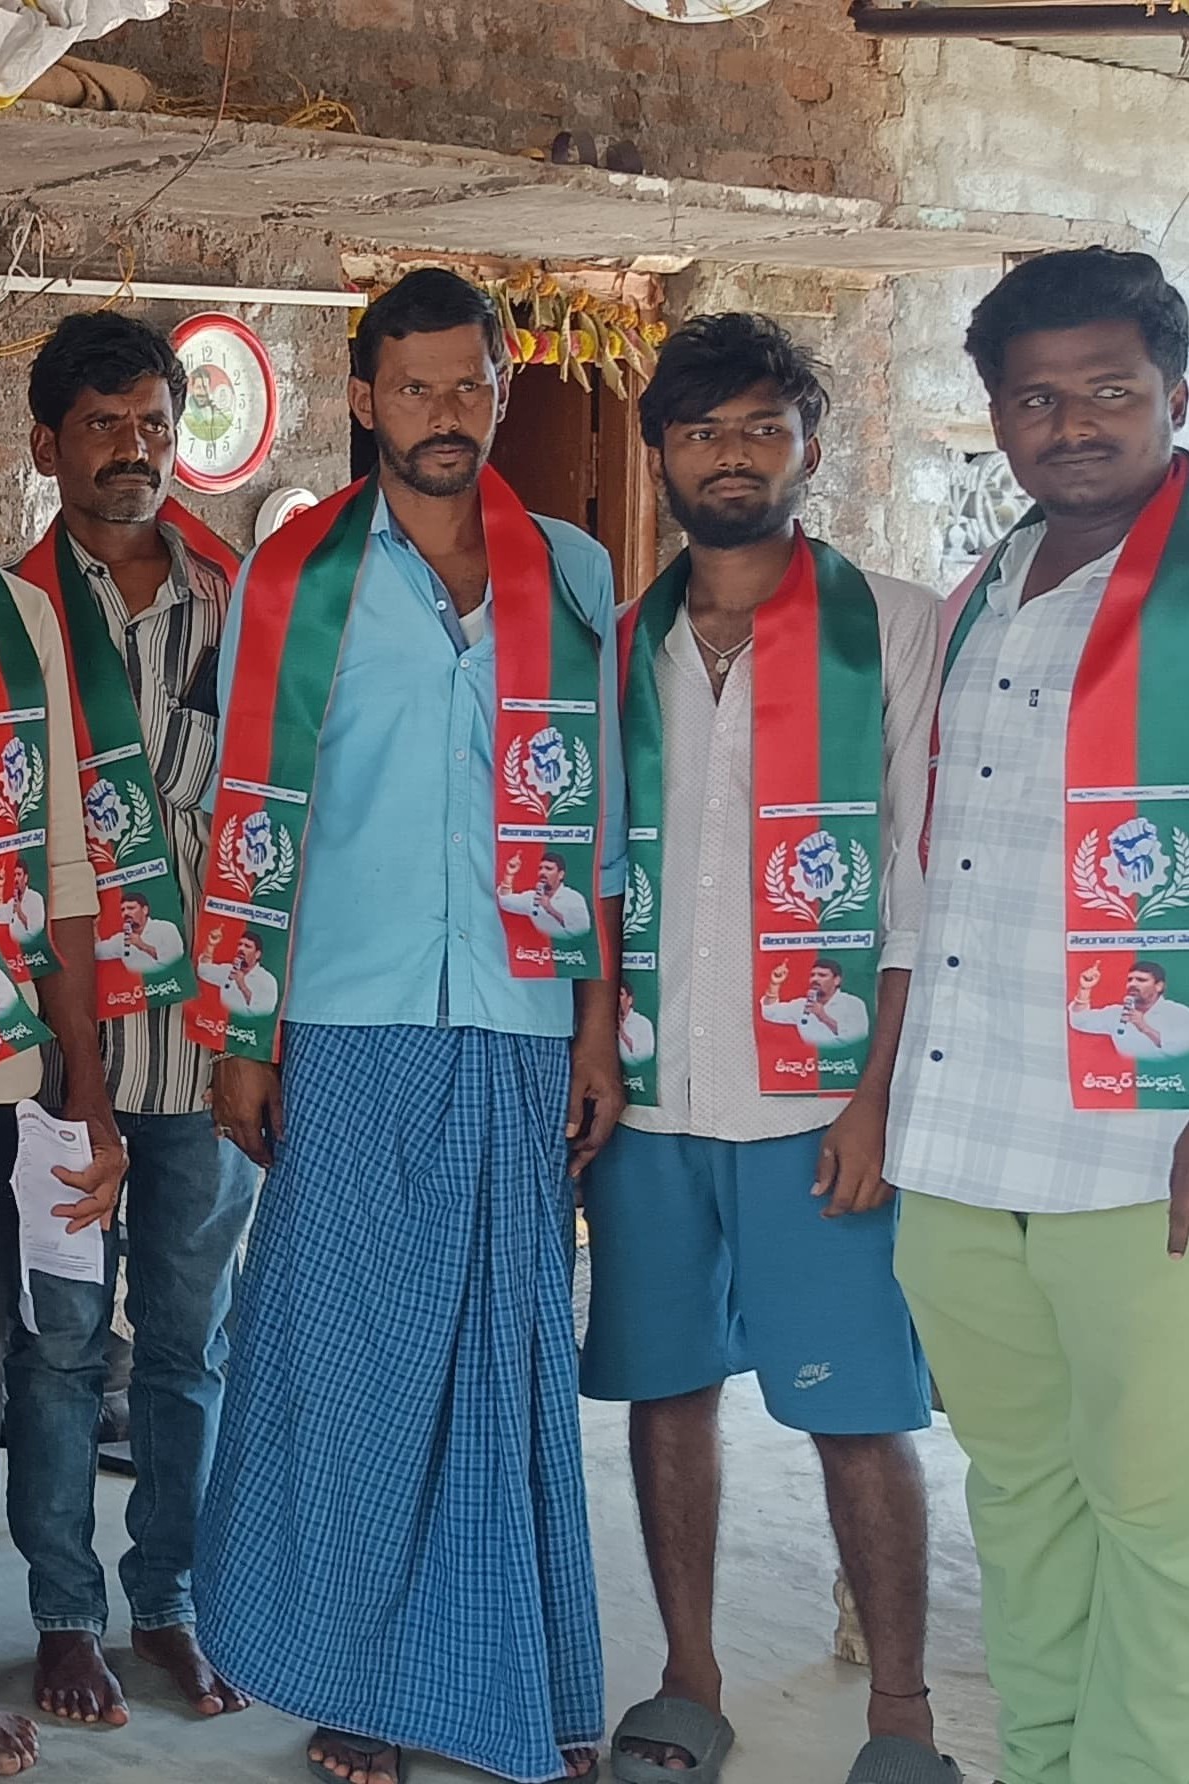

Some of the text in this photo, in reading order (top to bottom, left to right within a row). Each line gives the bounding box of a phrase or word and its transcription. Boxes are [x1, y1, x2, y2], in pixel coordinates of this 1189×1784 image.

[202, 345, 212, 362] 12
[234, 369, 241, 386] 2
[234, 417, 242, 433] 4
[188, 437, 196, 454] 7
[205, 443, 213, 459] 6
[222, 435, 230, 452] 5
[1082, 1071, 1186, 1095] తీన్మార్ మల్లన్న
[799, 1361, 831, 1378] NIKE
